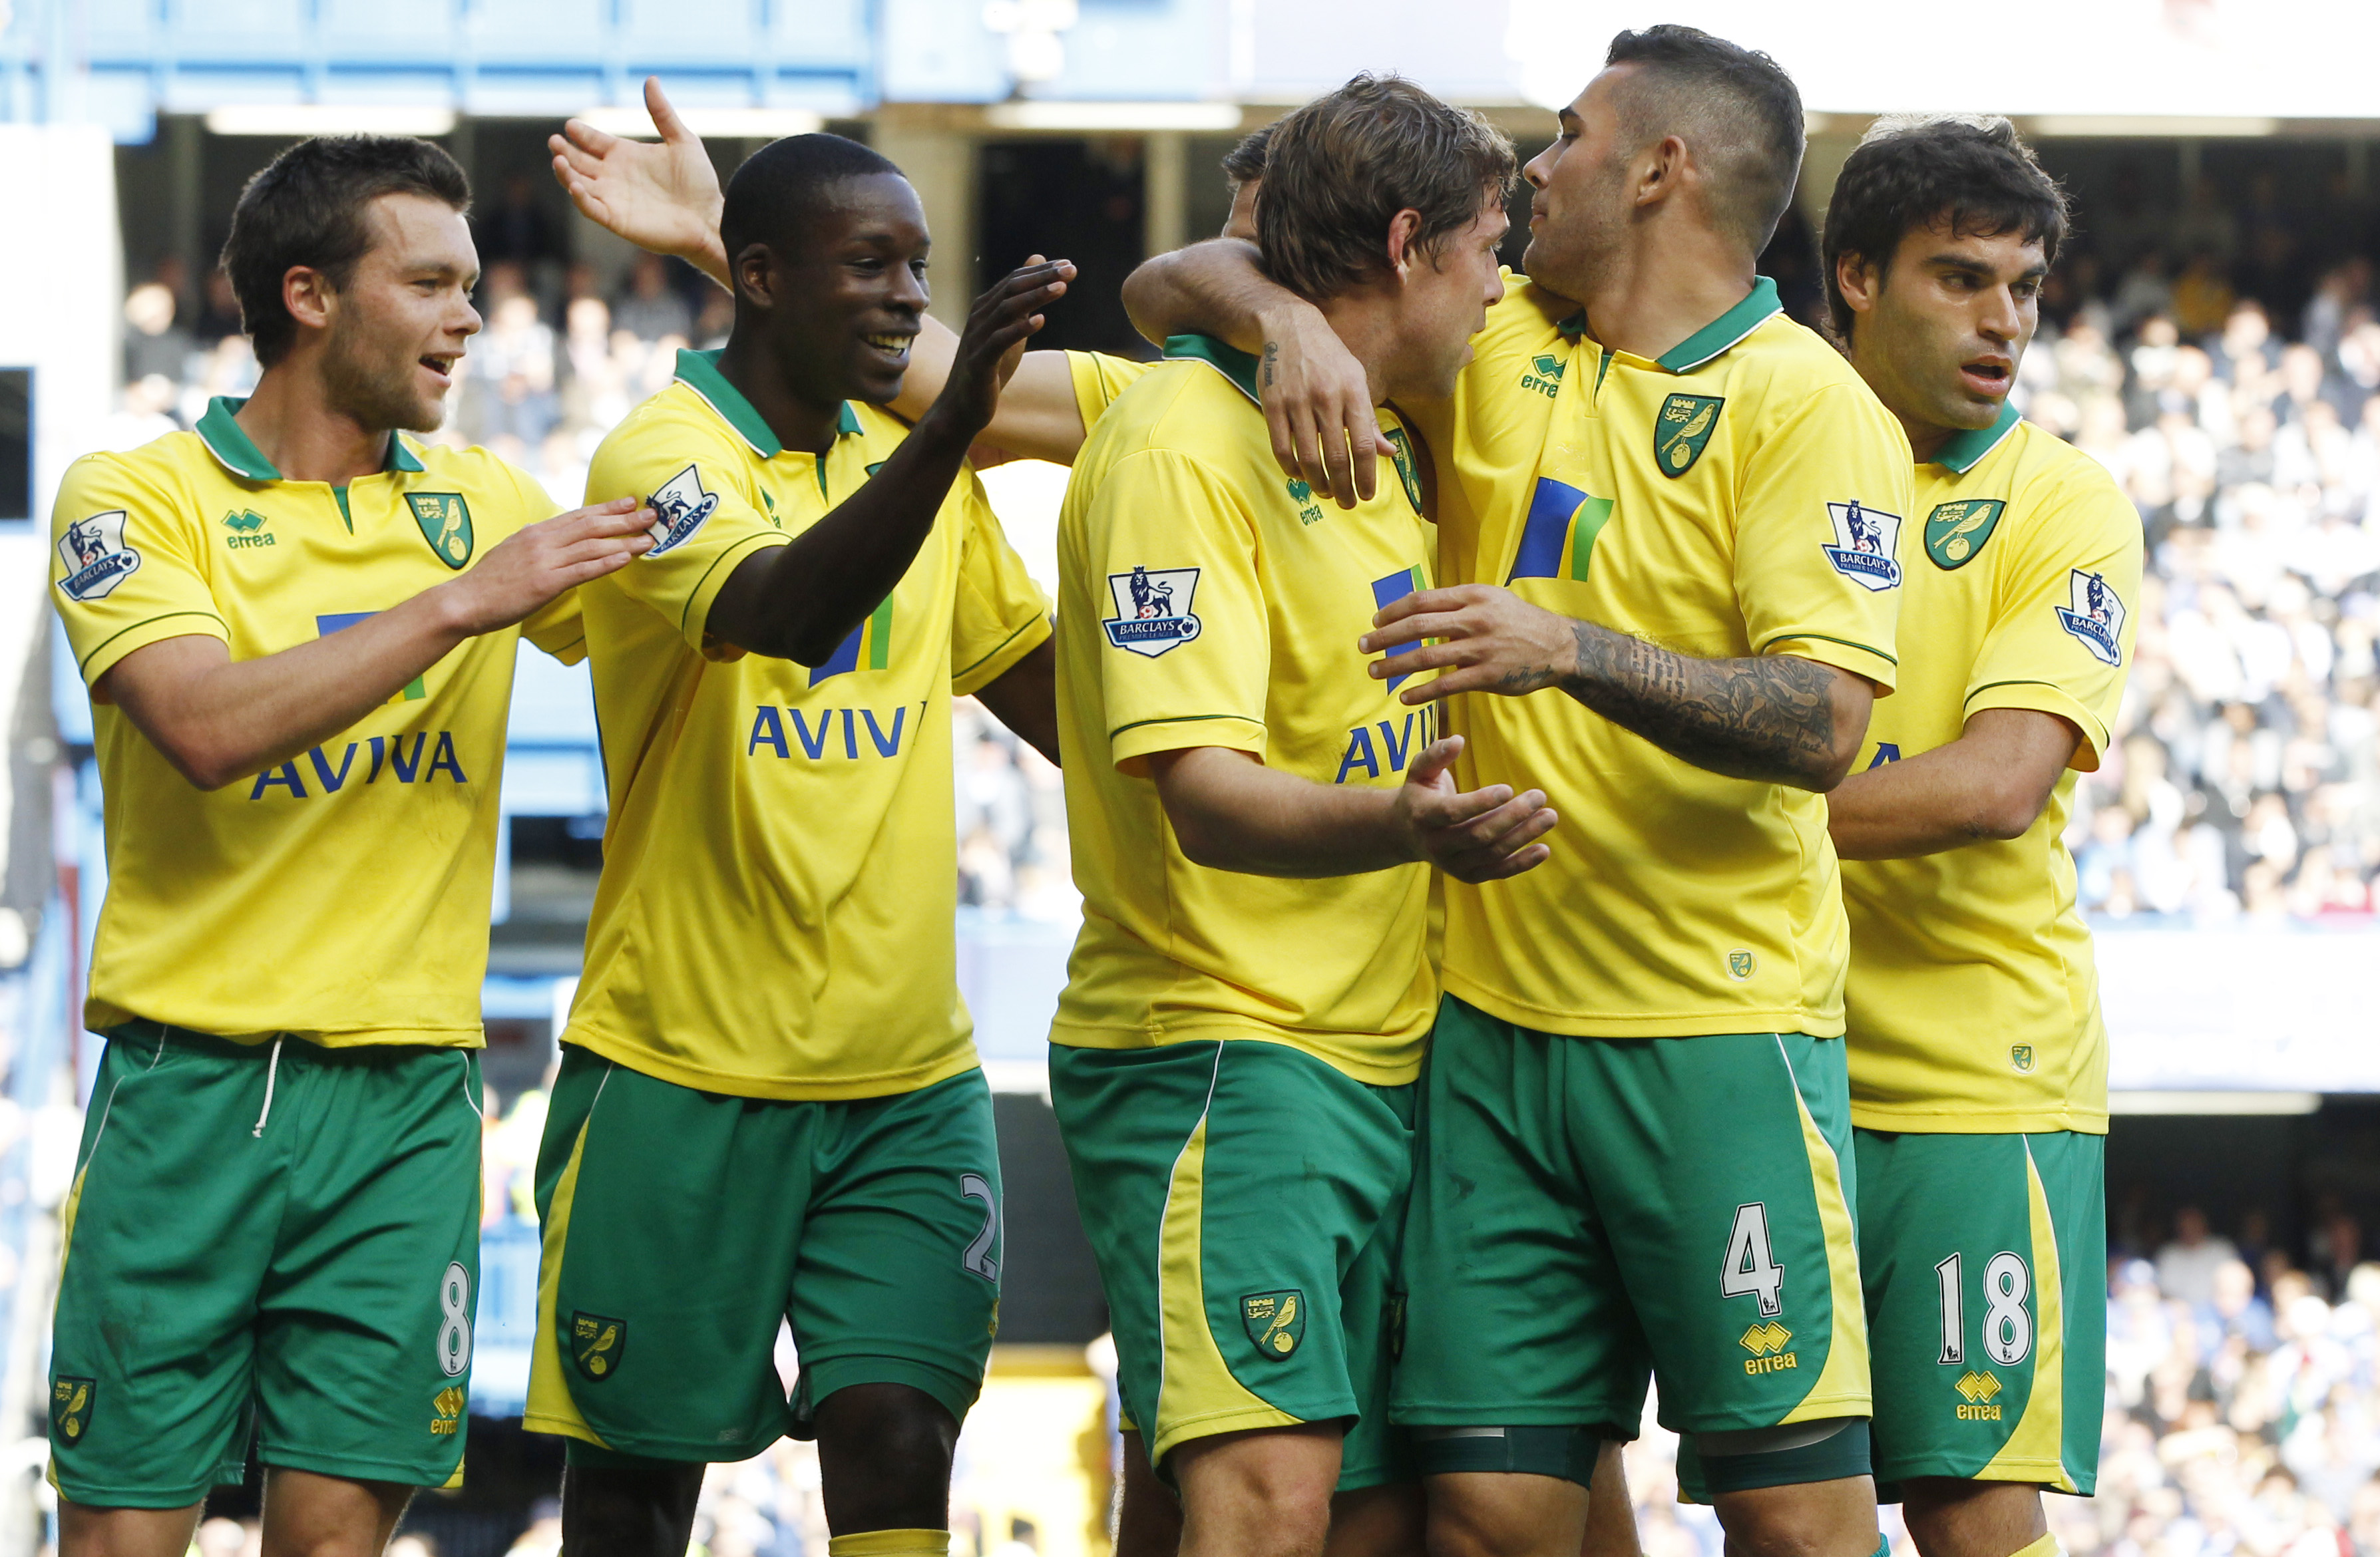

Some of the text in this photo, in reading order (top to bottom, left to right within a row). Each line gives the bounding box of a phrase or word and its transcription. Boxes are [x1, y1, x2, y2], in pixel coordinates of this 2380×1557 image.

[1300, 504, 1324, 526] errea
[226, 532, 276, 549] errea
[73, 558, 116, 590] BARCLAYS
[1840, 552, 1886, 570] BARCLAYS
[1840, 562, 1866, 572] PREMIER
[1119, 620, 1175, 635] BARCLAYS
[1119, 632, 1148, 641] PREMIER
[2072, 616, 2111, 647] BARCLAYS
[748, 701, 927, 759] AVIV
[250, 731, 468, 800] AVIVA
[960, 1173, 998, 1284] 2
[1720, 1202, 1785, 1318] 4
[437, 1261, 473, 1377] 8
[1934, 1251, 2033, 1366] 18
[1744, 1351, 1798, 1375] errea
[1957, 1404, 2002, 1421] errea
